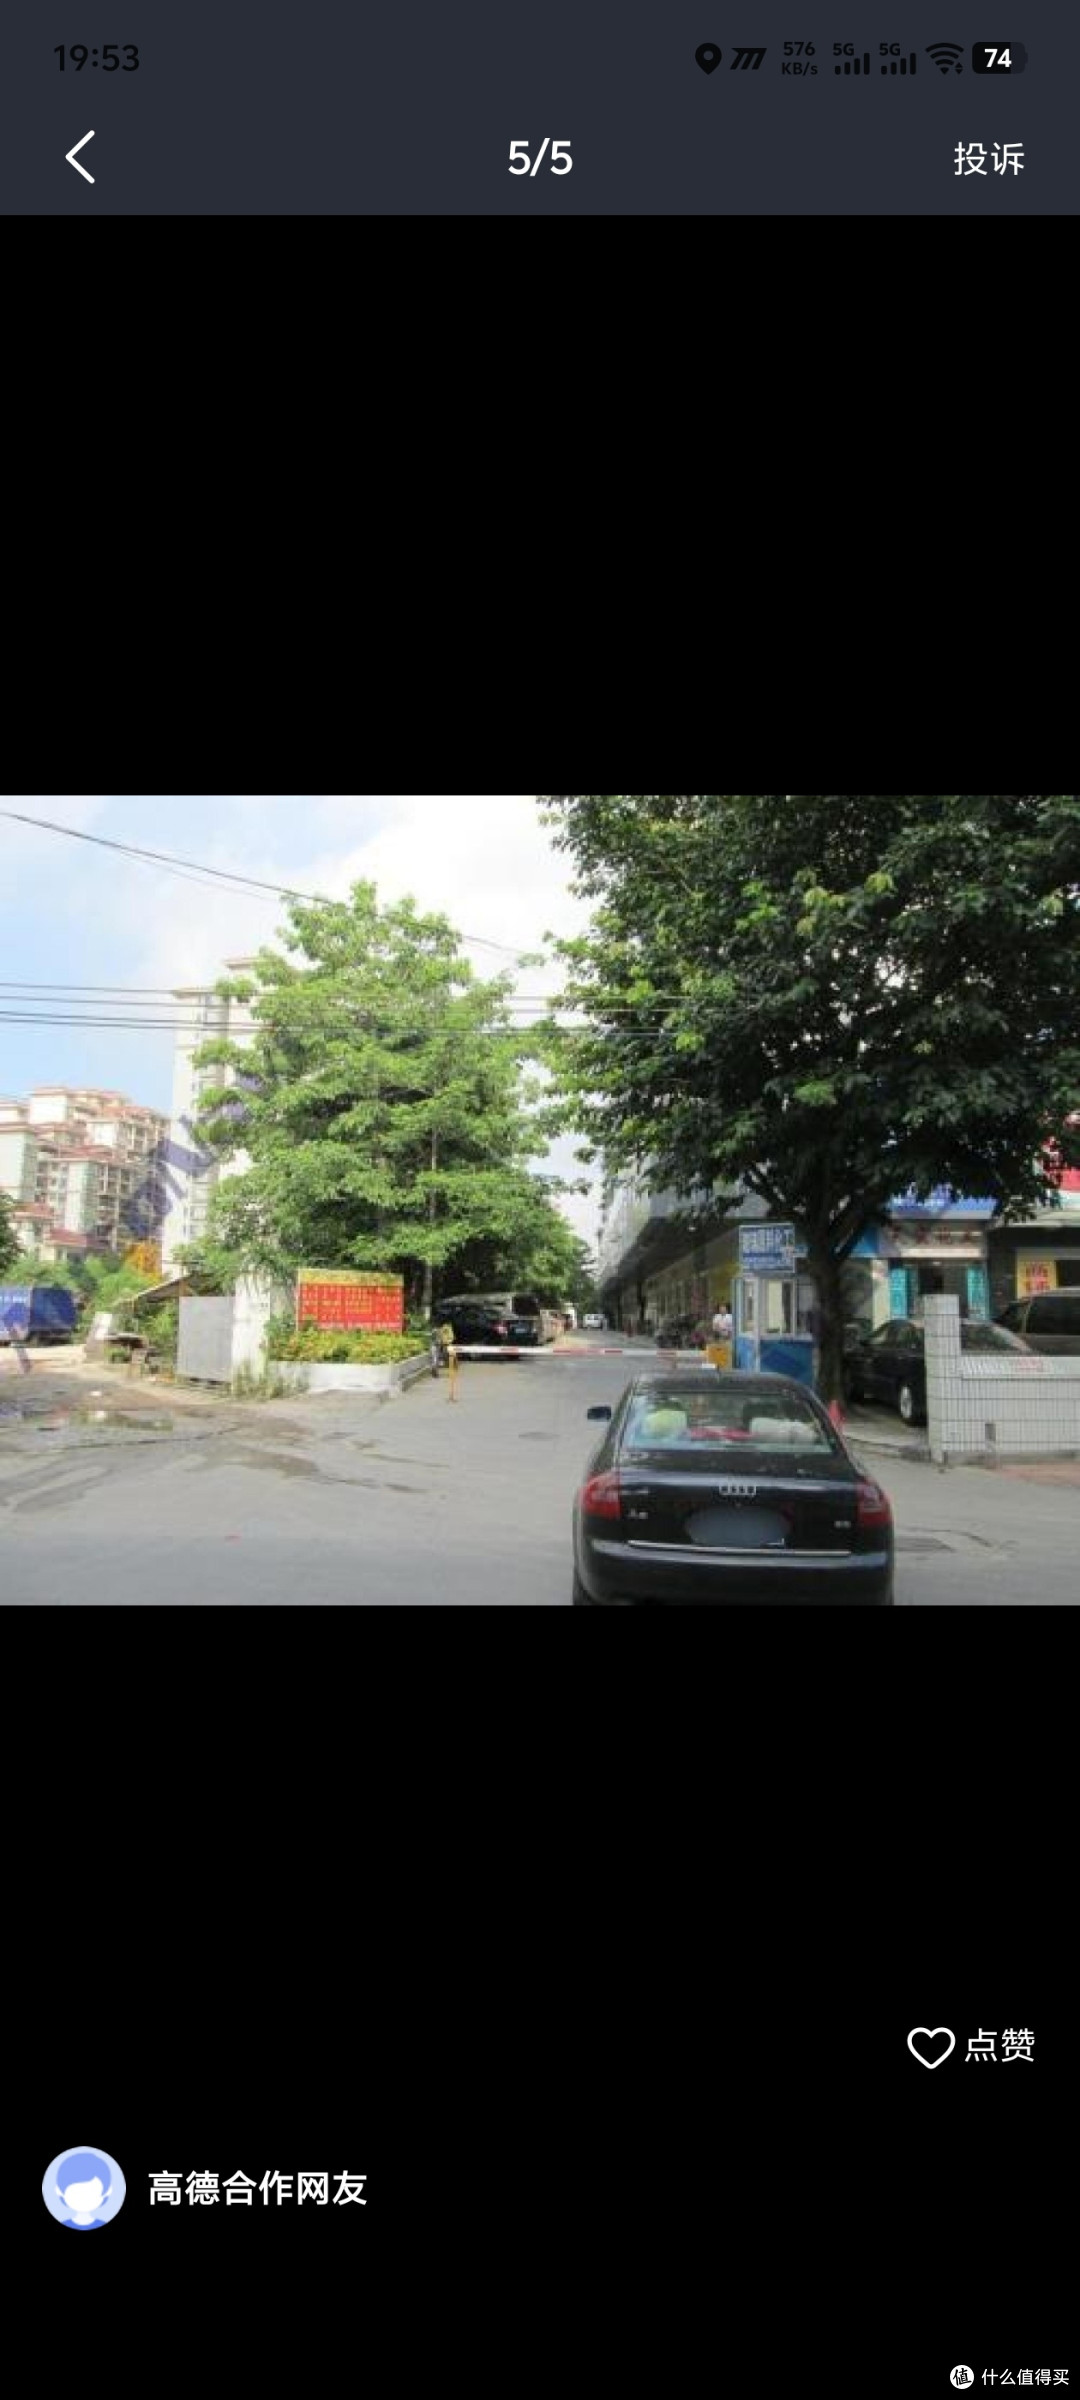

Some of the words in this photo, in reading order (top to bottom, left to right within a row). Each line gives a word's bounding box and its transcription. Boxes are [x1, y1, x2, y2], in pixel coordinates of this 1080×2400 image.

[54, 45, 140, 71] 19:53
[783, 42, 816, 56] 576
[833, 43, 855, 56] 5G
[879, 43, 901, 56] 5G
[984, 48, 1012, 68] 74
[782, 62, 818, 76] KB/s
[507, 138, 574, 177] 5/5
[953, 141, 1026, 177] 投诉
[964, 2027, 1036, 2063] 点赞
[148, 2169, 368, 2206] 高德合作网友
